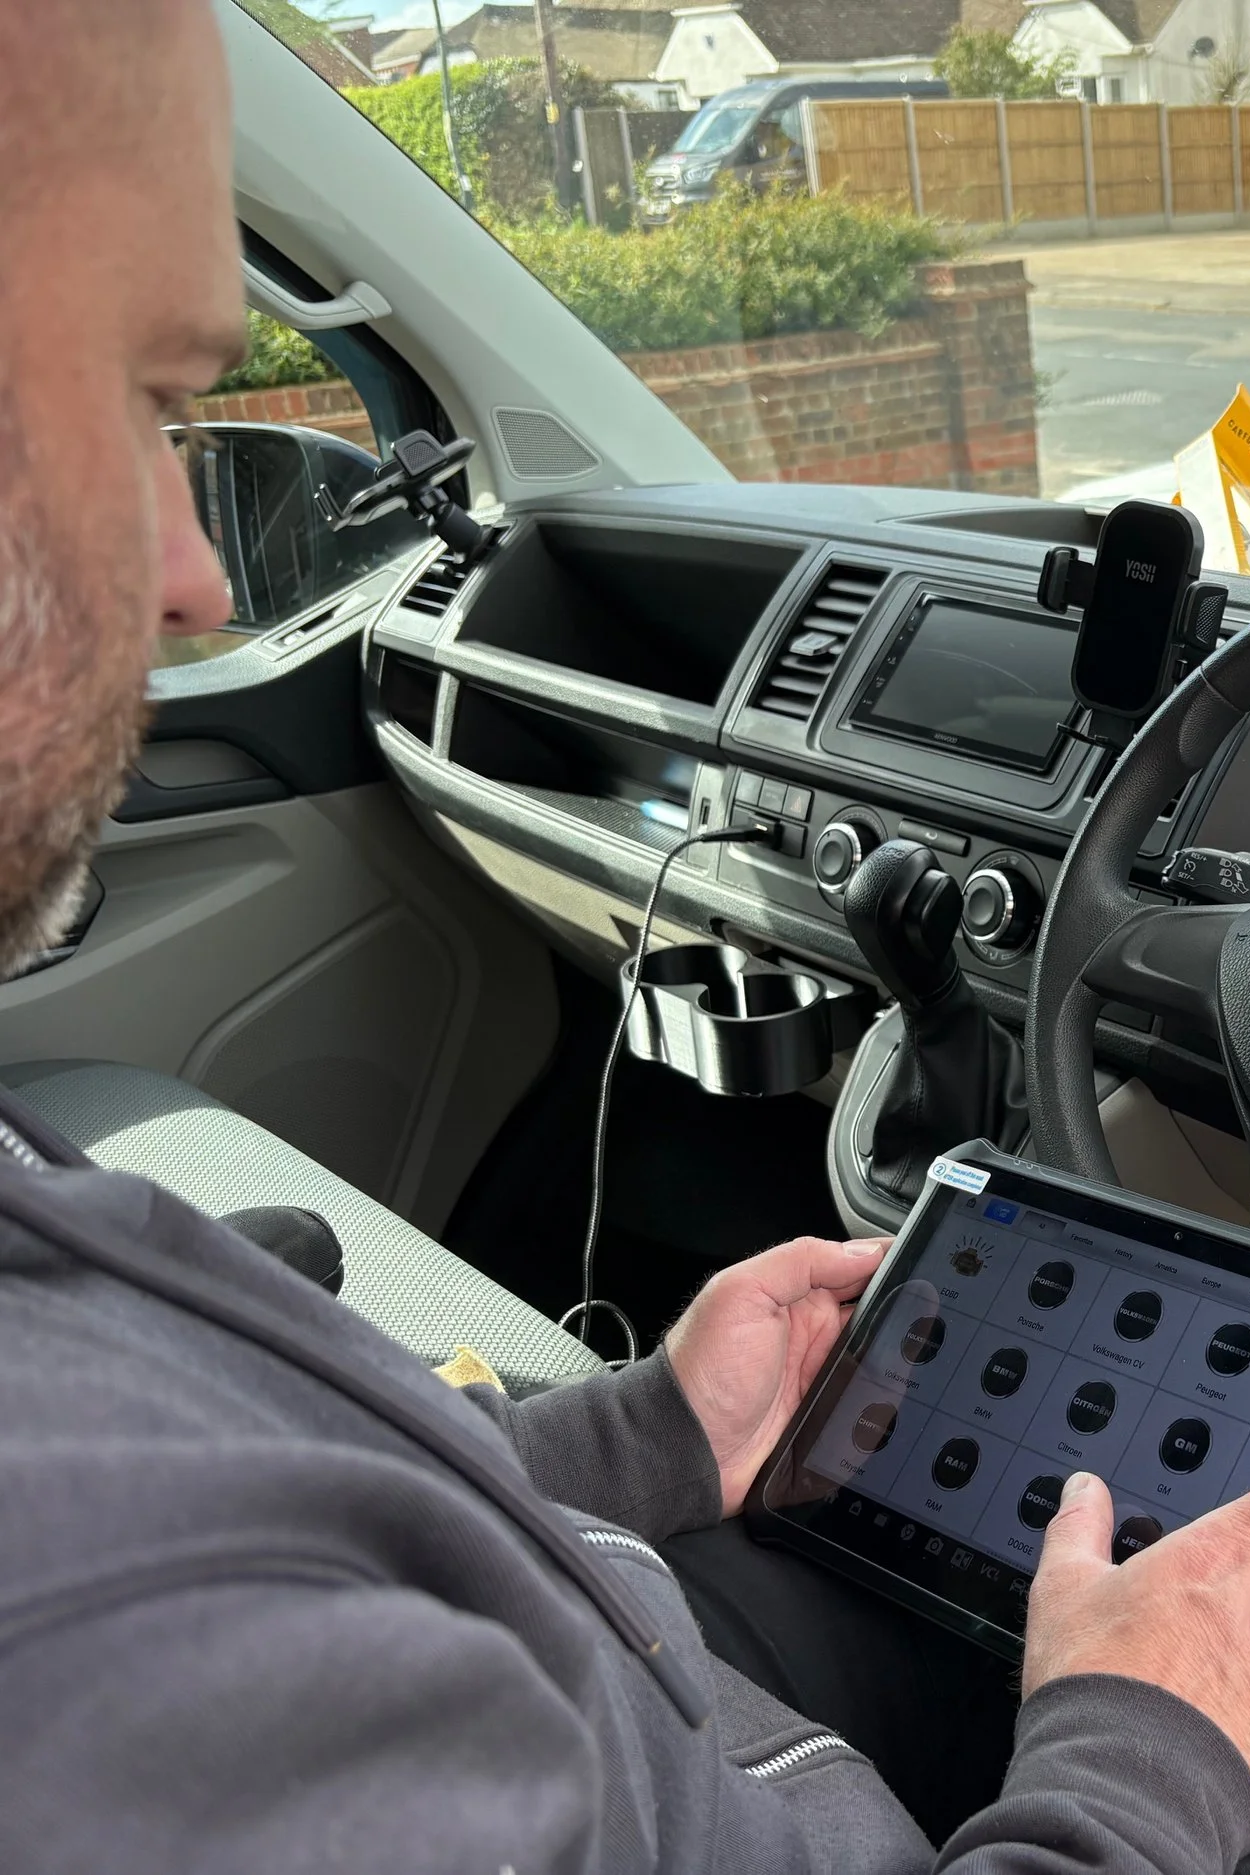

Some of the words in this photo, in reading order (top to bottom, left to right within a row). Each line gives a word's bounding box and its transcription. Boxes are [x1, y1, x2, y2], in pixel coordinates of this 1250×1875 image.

[1114, 1247, 1133, 1260] History
[1154, 1261, 1178, 1274] America
[1034, 1275, 1072, 1292] PORSCHE
[1201, 1276, 1222, 1289] Europe
[1016, 1315, 1044, 1333] Porsche
[1092, 1343, 1133, 1367] Volkswagen
[1133, 1357, 1145, 1370] CV
[991, 1363, 1019, 1381] BMW
[1196, 1382, 1227, 1402] Peugeot
[973, 1405, 994, 1420] BMW
[1057, 1441, 1083, 1459] Citroen
[1174, 1437, 1199, 1455] GM
[944, 1455, 969, 1472] RAM
[1156, 1482, 1172, 1496] GM
[924, 1498, 943, 1513] RAM
[1007, 1537, 1035, 1556] DODGE
[1122, 1536, 1148, 1550] JEE
